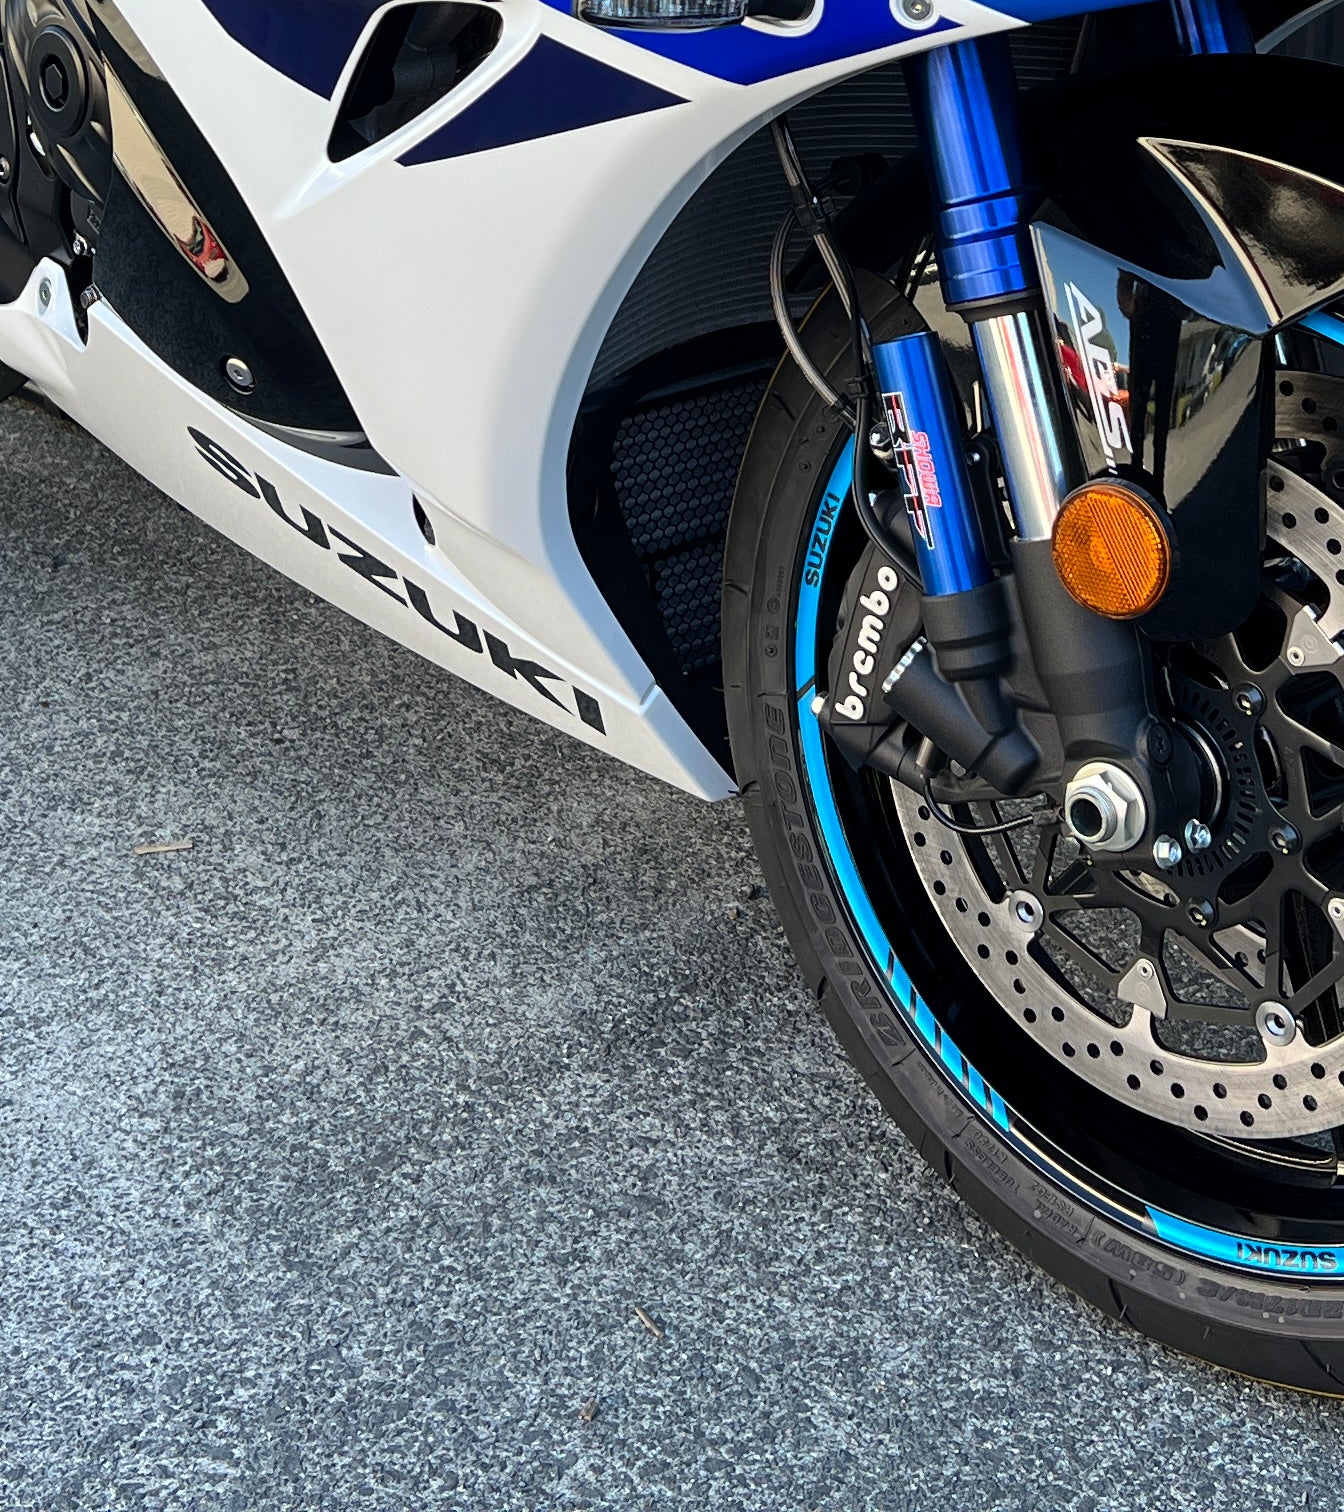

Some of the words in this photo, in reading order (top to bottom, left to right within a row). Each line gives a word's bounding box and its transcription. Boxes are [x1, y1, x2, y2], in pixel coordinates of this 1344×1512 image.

[1068, 281, 1134, 454] ABS
[805, 492, 841, 589] SUZUKI
[911, 430, 943, 508] SHOWA
[186, 424, 607, 738] SUZUKI
[834, 566, 899, 721] brembo
[762, 703, 908, 1048] BRIDGESTONE
[1236, 1241, 1340, 1272] SUZUKI
